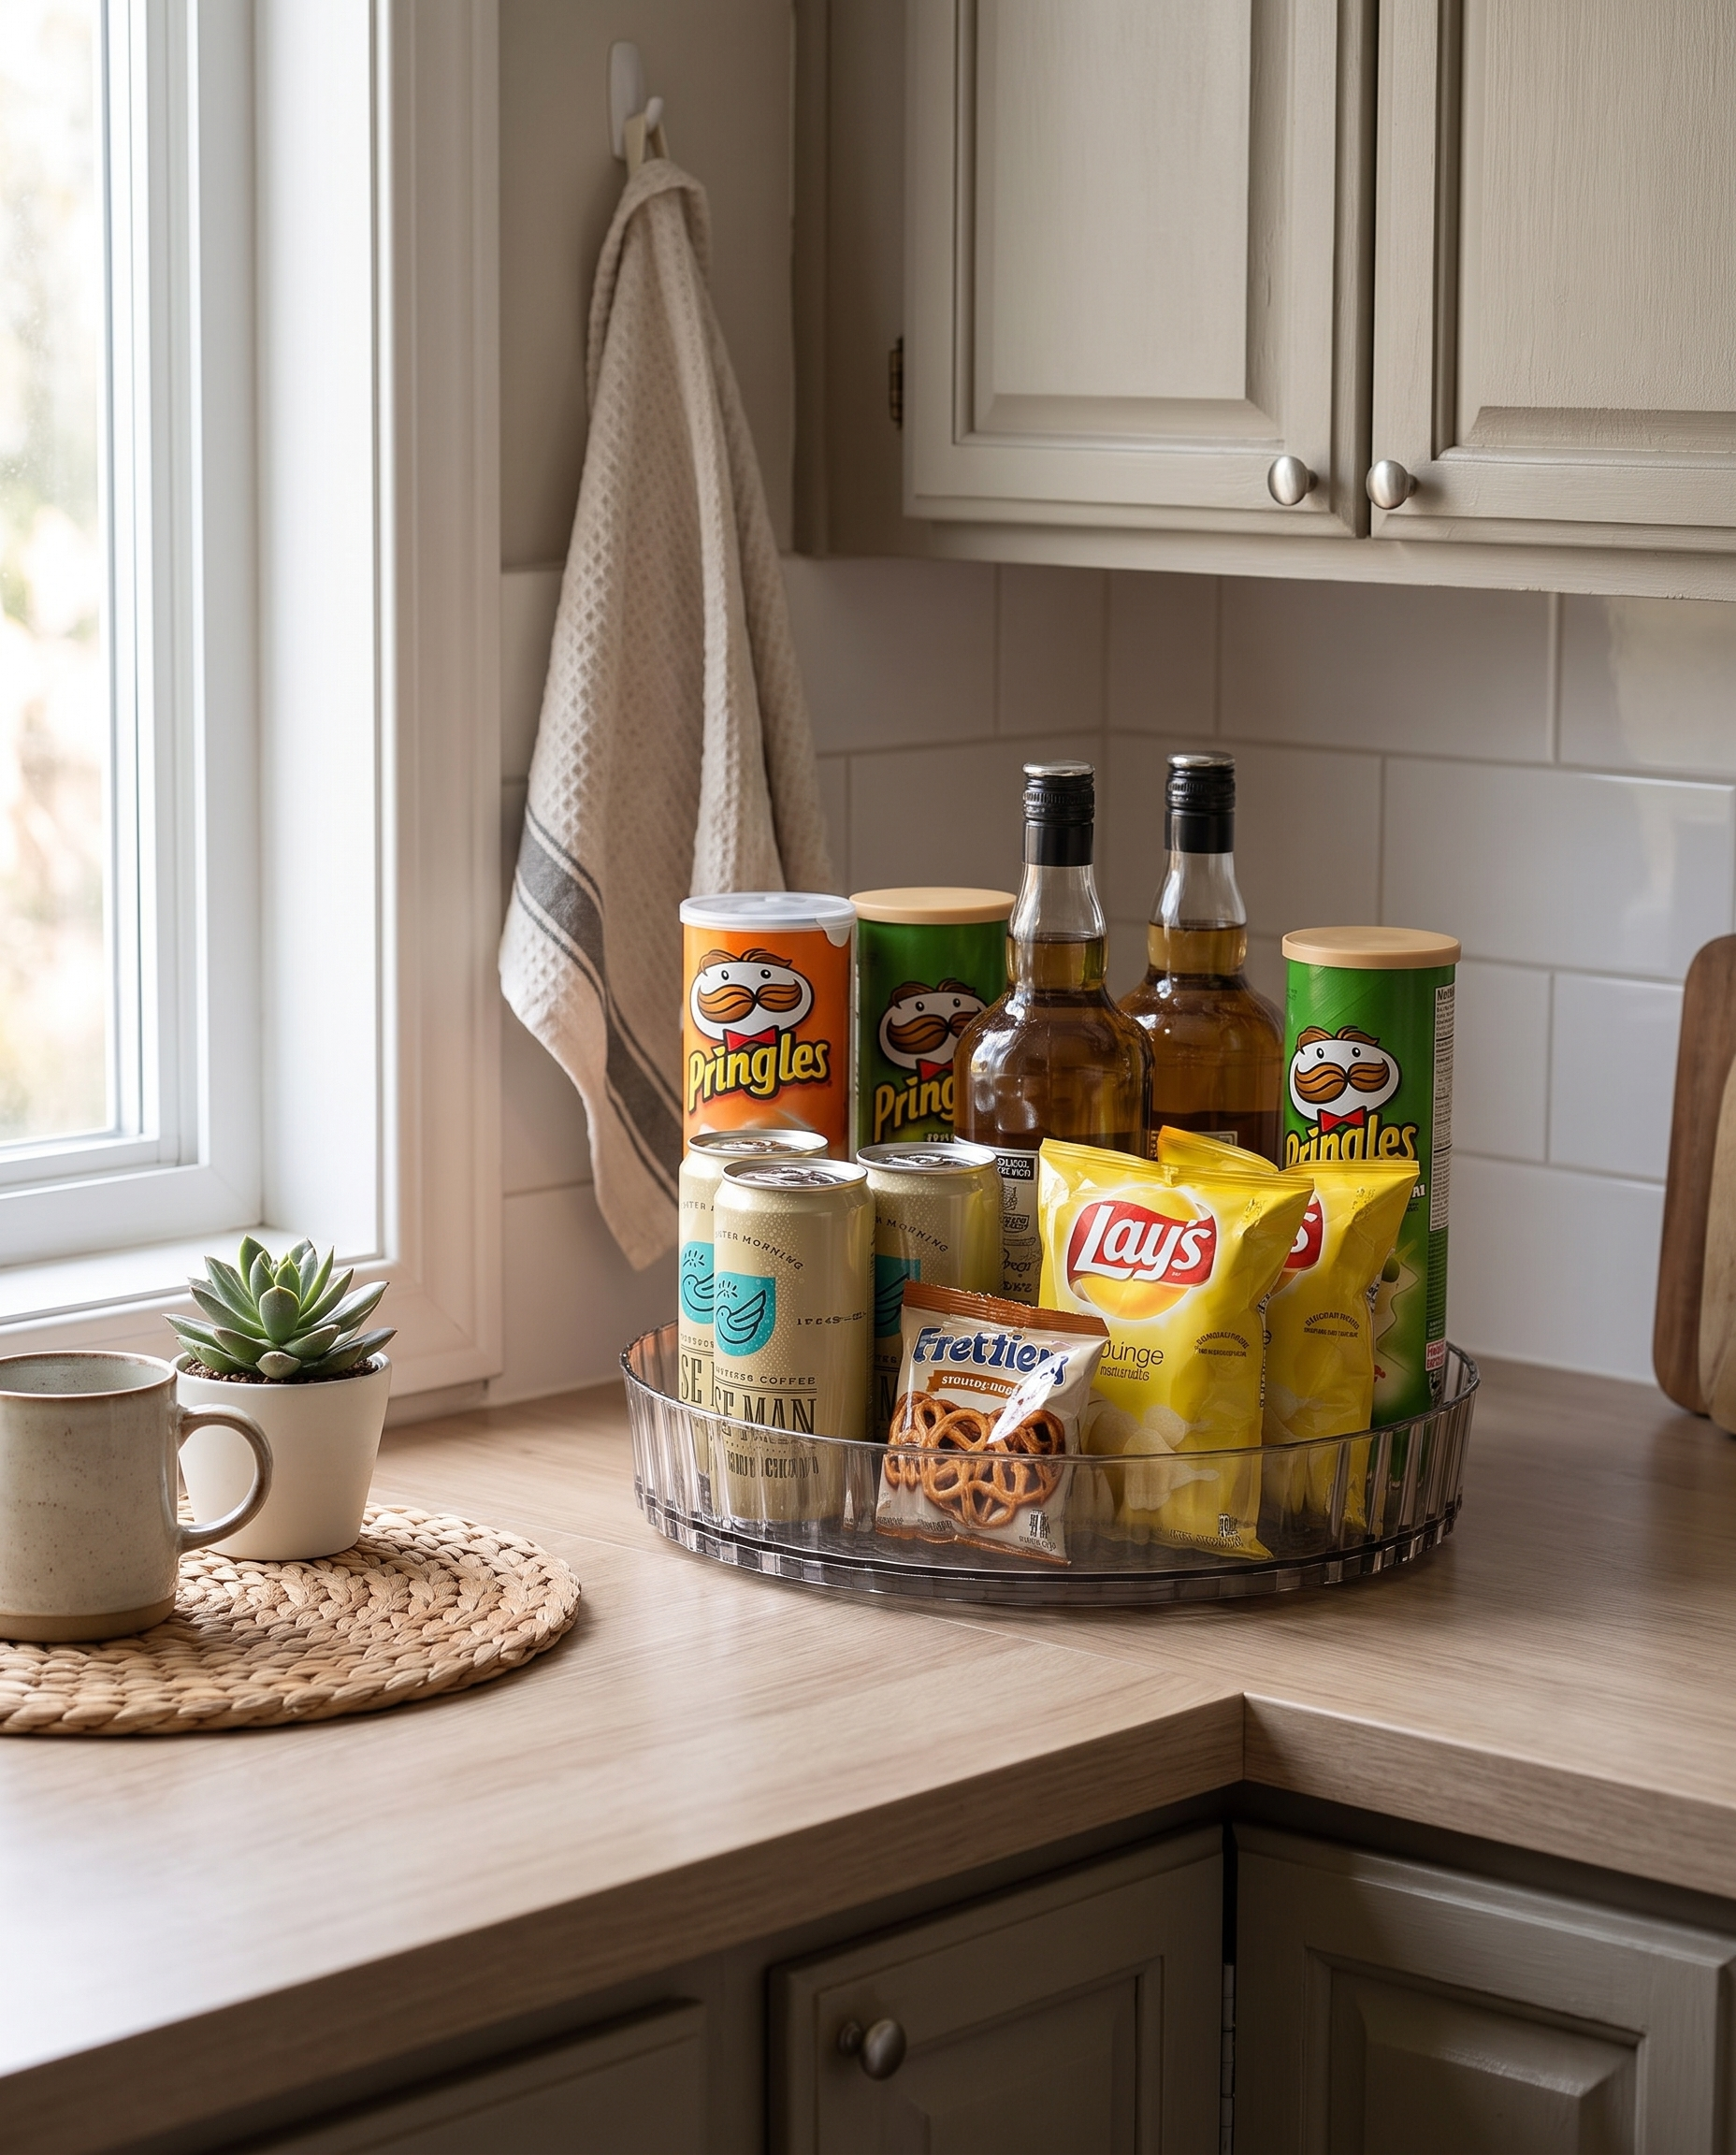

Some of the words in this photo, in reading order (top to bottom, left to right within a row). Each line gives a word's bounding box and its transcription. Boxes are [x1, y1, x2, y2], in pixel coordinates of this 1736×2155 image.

[687, 1033, 830, 1113] Pringles
[875, 1077, 954, 1142] Pring
[1073, 1204, 1213, 1281] Lay's
[742, 1394, 817, 1436] MAN
